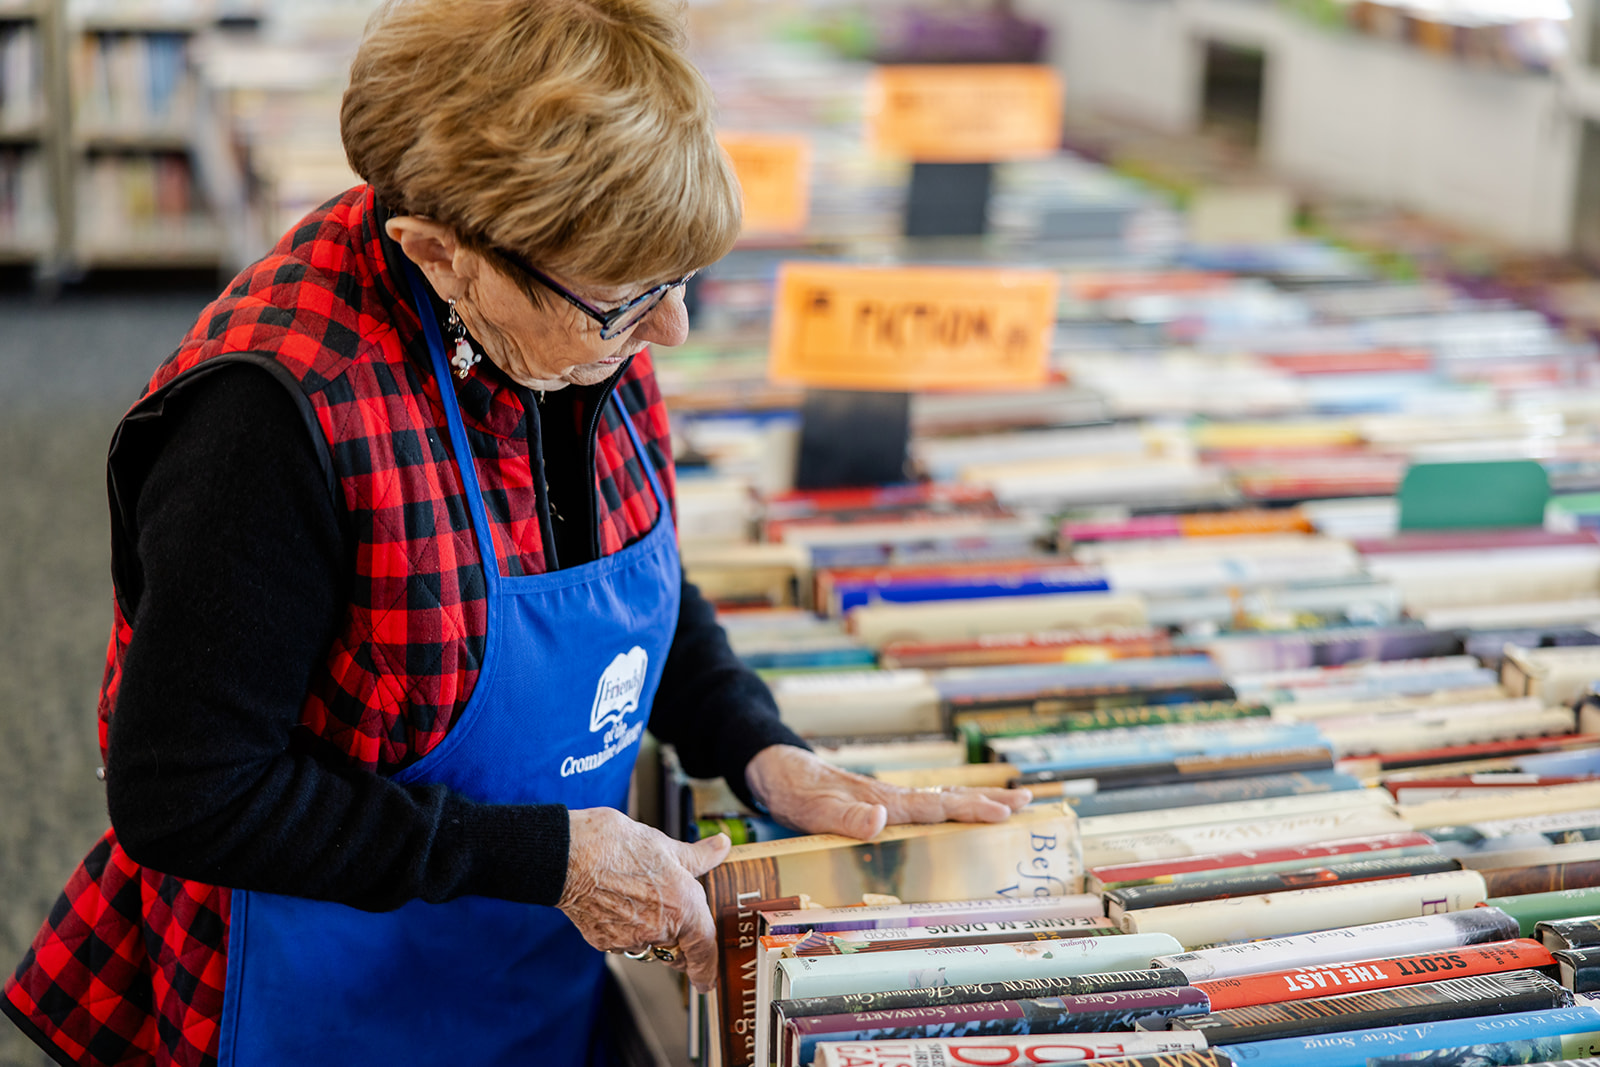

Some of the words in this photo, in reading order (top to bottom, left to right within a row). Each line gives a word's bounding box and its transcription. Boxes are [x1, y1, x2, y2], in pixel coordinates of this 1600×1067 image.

[604, 668, 640, 701] Friends
[603, 723, 617, 744] of
[1016, 831, 1066, 898] Befo
[735, 888, 762, 949] Lisa
[1022, 916, 1097, 930] JEANNE
[1360, 918, 1429, 934] Sorrow
[863, 930, 909, 940] BLOOD
[923, 921, 989, 935] DAMS
[1305, 928, 1355, 944] Road
[1219, 943, 1261, 955] Keller
[1262, 937, 1294, 949] Julia
[1395, 955, 1468, 976] SCOTT
[1077, 968, 1161, 986] CATHERINE
[1282, 971, 1342, 993] LAST
[1345, 965, 1389, 984] THE
[999, 976, 1072, 993] COOKSON
[842, 992, 875, 1004] Girl
[853, 1007, 947, 1022] SCHWARTZ
[1551, 1011, 1586, 1023] JAN
[1475, 1015, 1547, 1031] KARON
[1360, 1029, 1408, 1046] New
[1414, 1024, 1435, 1040] A
[1301, 1036, 1356, 1050] Song
